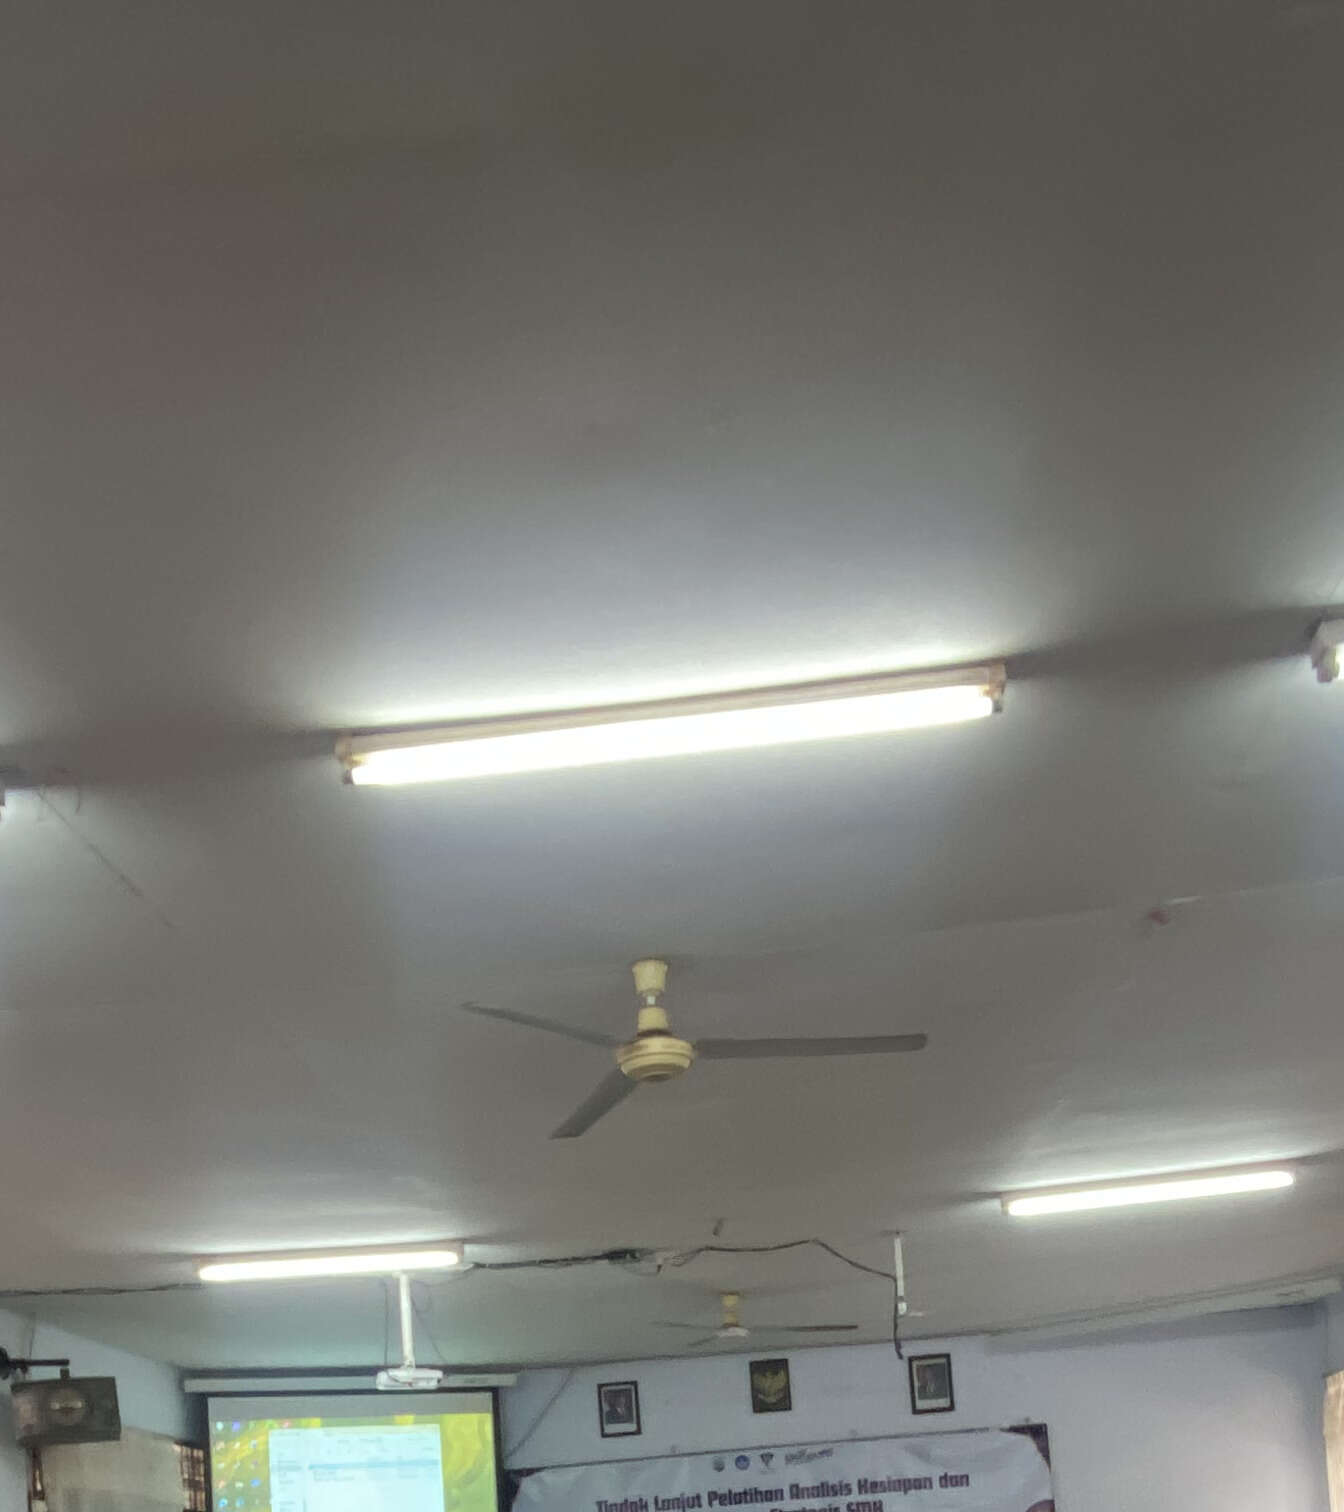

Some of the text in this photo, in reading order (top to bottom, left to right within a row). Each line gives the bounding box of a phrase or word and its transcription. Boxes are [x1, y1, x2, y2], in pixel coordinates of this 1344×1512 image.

[654, 1493, 703, 1512] Lanjut
[707, 1486, 785, 1507] Pelatihan
[789, 1481, 852, 1500] Analisis
[857, 1476, 933, 1496] Kesiapan
[938, 1472, 970, 1488] dan
